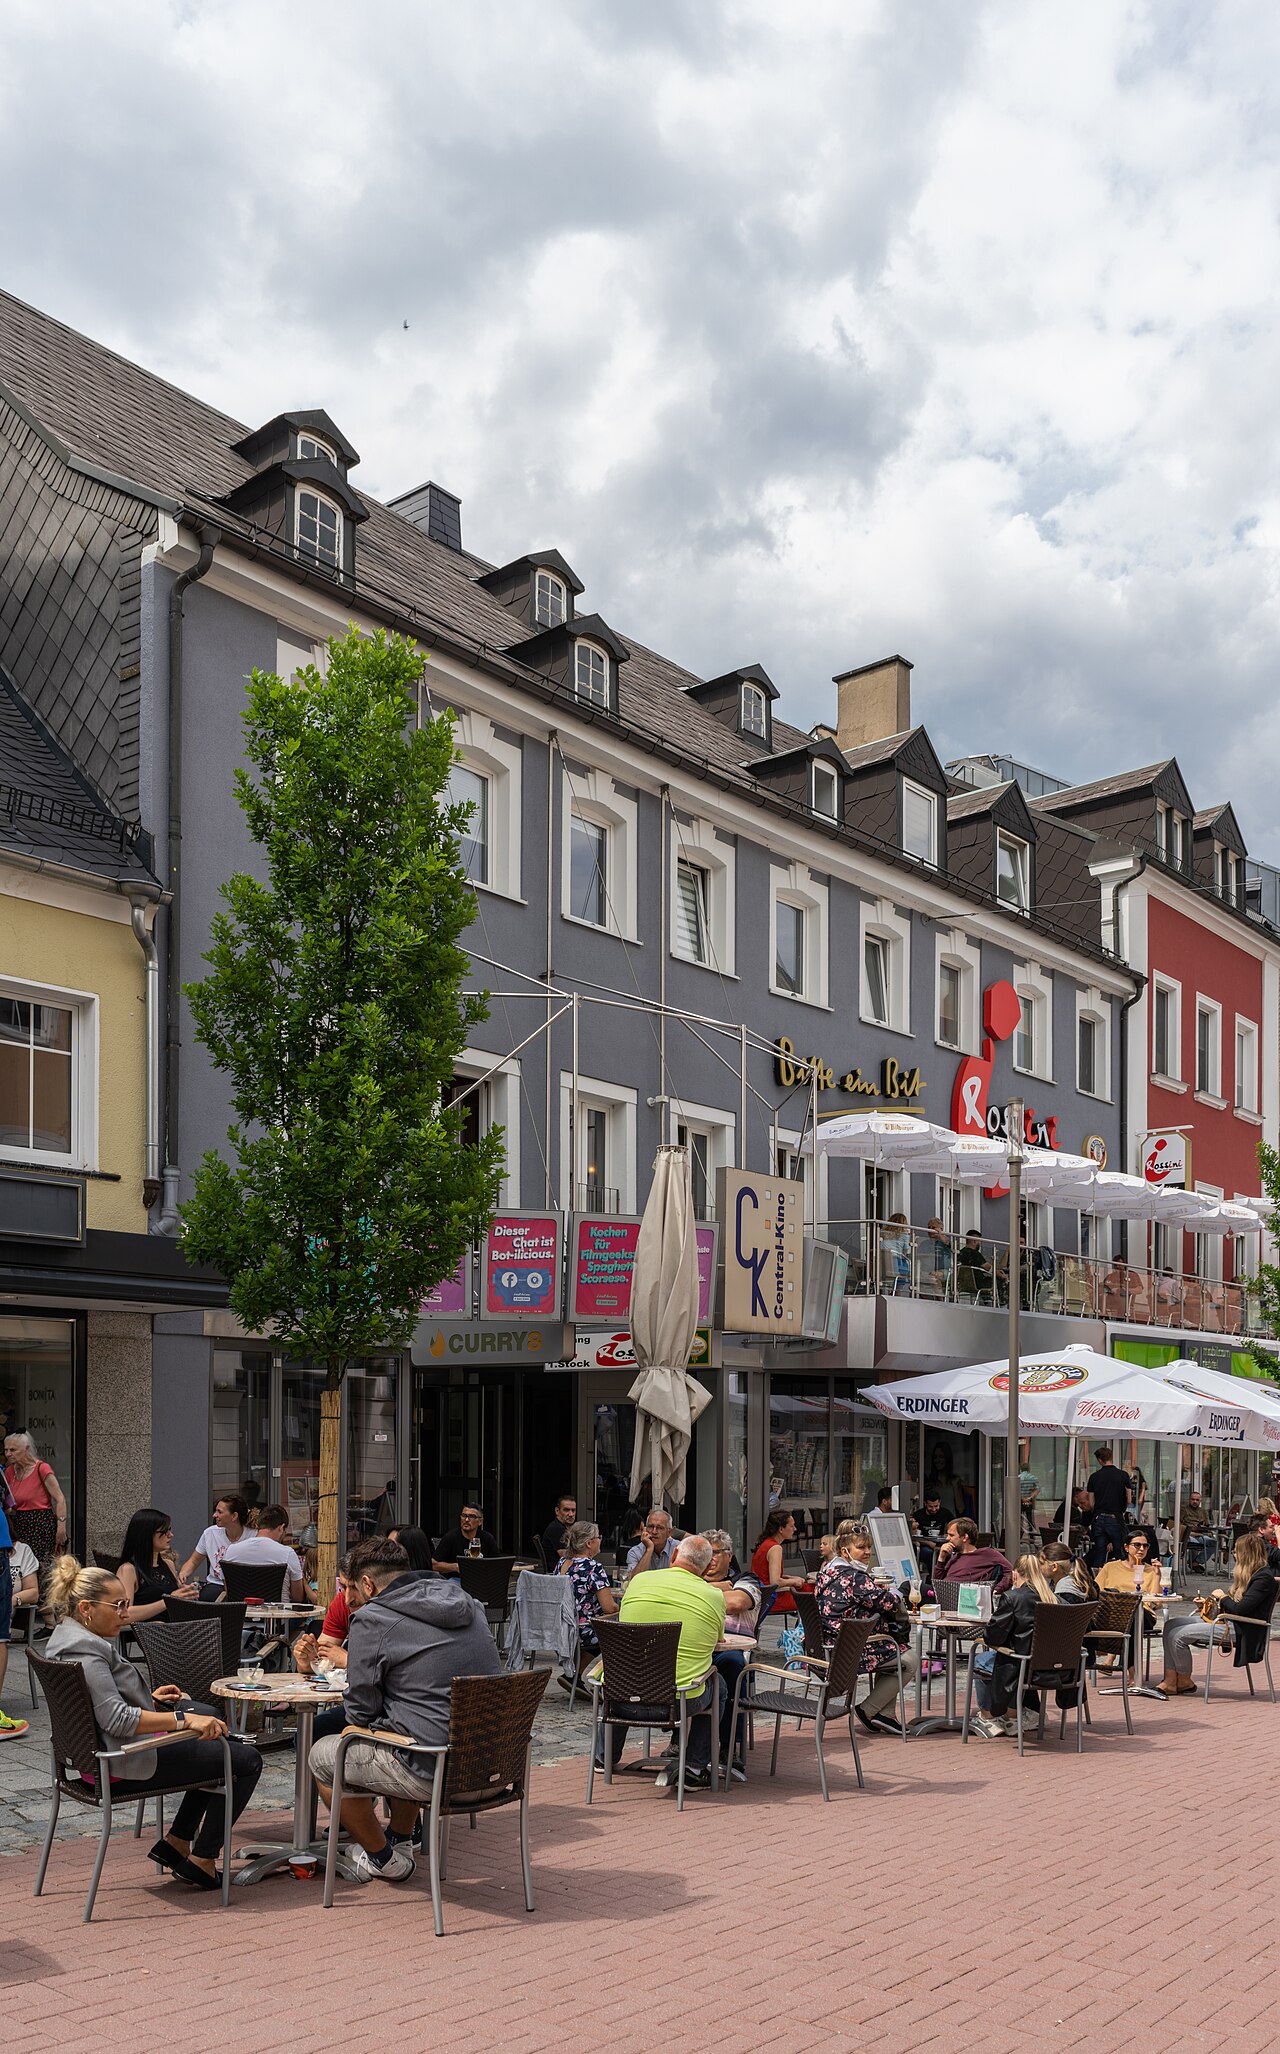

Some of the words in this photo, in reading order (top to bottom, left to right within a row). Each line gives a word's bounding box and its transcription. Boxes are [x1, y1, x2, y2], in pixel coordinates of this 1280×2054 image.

[776, 1035, 837, 1091] Bitte
[841, 1067, 880, 1096] ein
[882, 1057, 928, 1099] Bit
[1146, 1159, 1183, 1171] Rossini
[494, 1225, 530, 1236] Dieser
[589, 1226, 628, 1238] Kochen
[512, 1237, 539, 1250] Chat
[540, 1236, 555, 1247] ist
[594, 1239, 611, 1250] für
[491, 1248, 555, 1261] Bot-ilicious.
[774, 1193, 786, 1319] Central-Kino
[580, 1273, 629, 1284] Scorsese.
[448, 1331, 543, 1354] CURRY8
[897, 1396, 970, 1415] ERDINGER
[1076, 1400, 1141, 1421] Weißbier
[1208, 1412, 1241, 1433] ERDINGER
